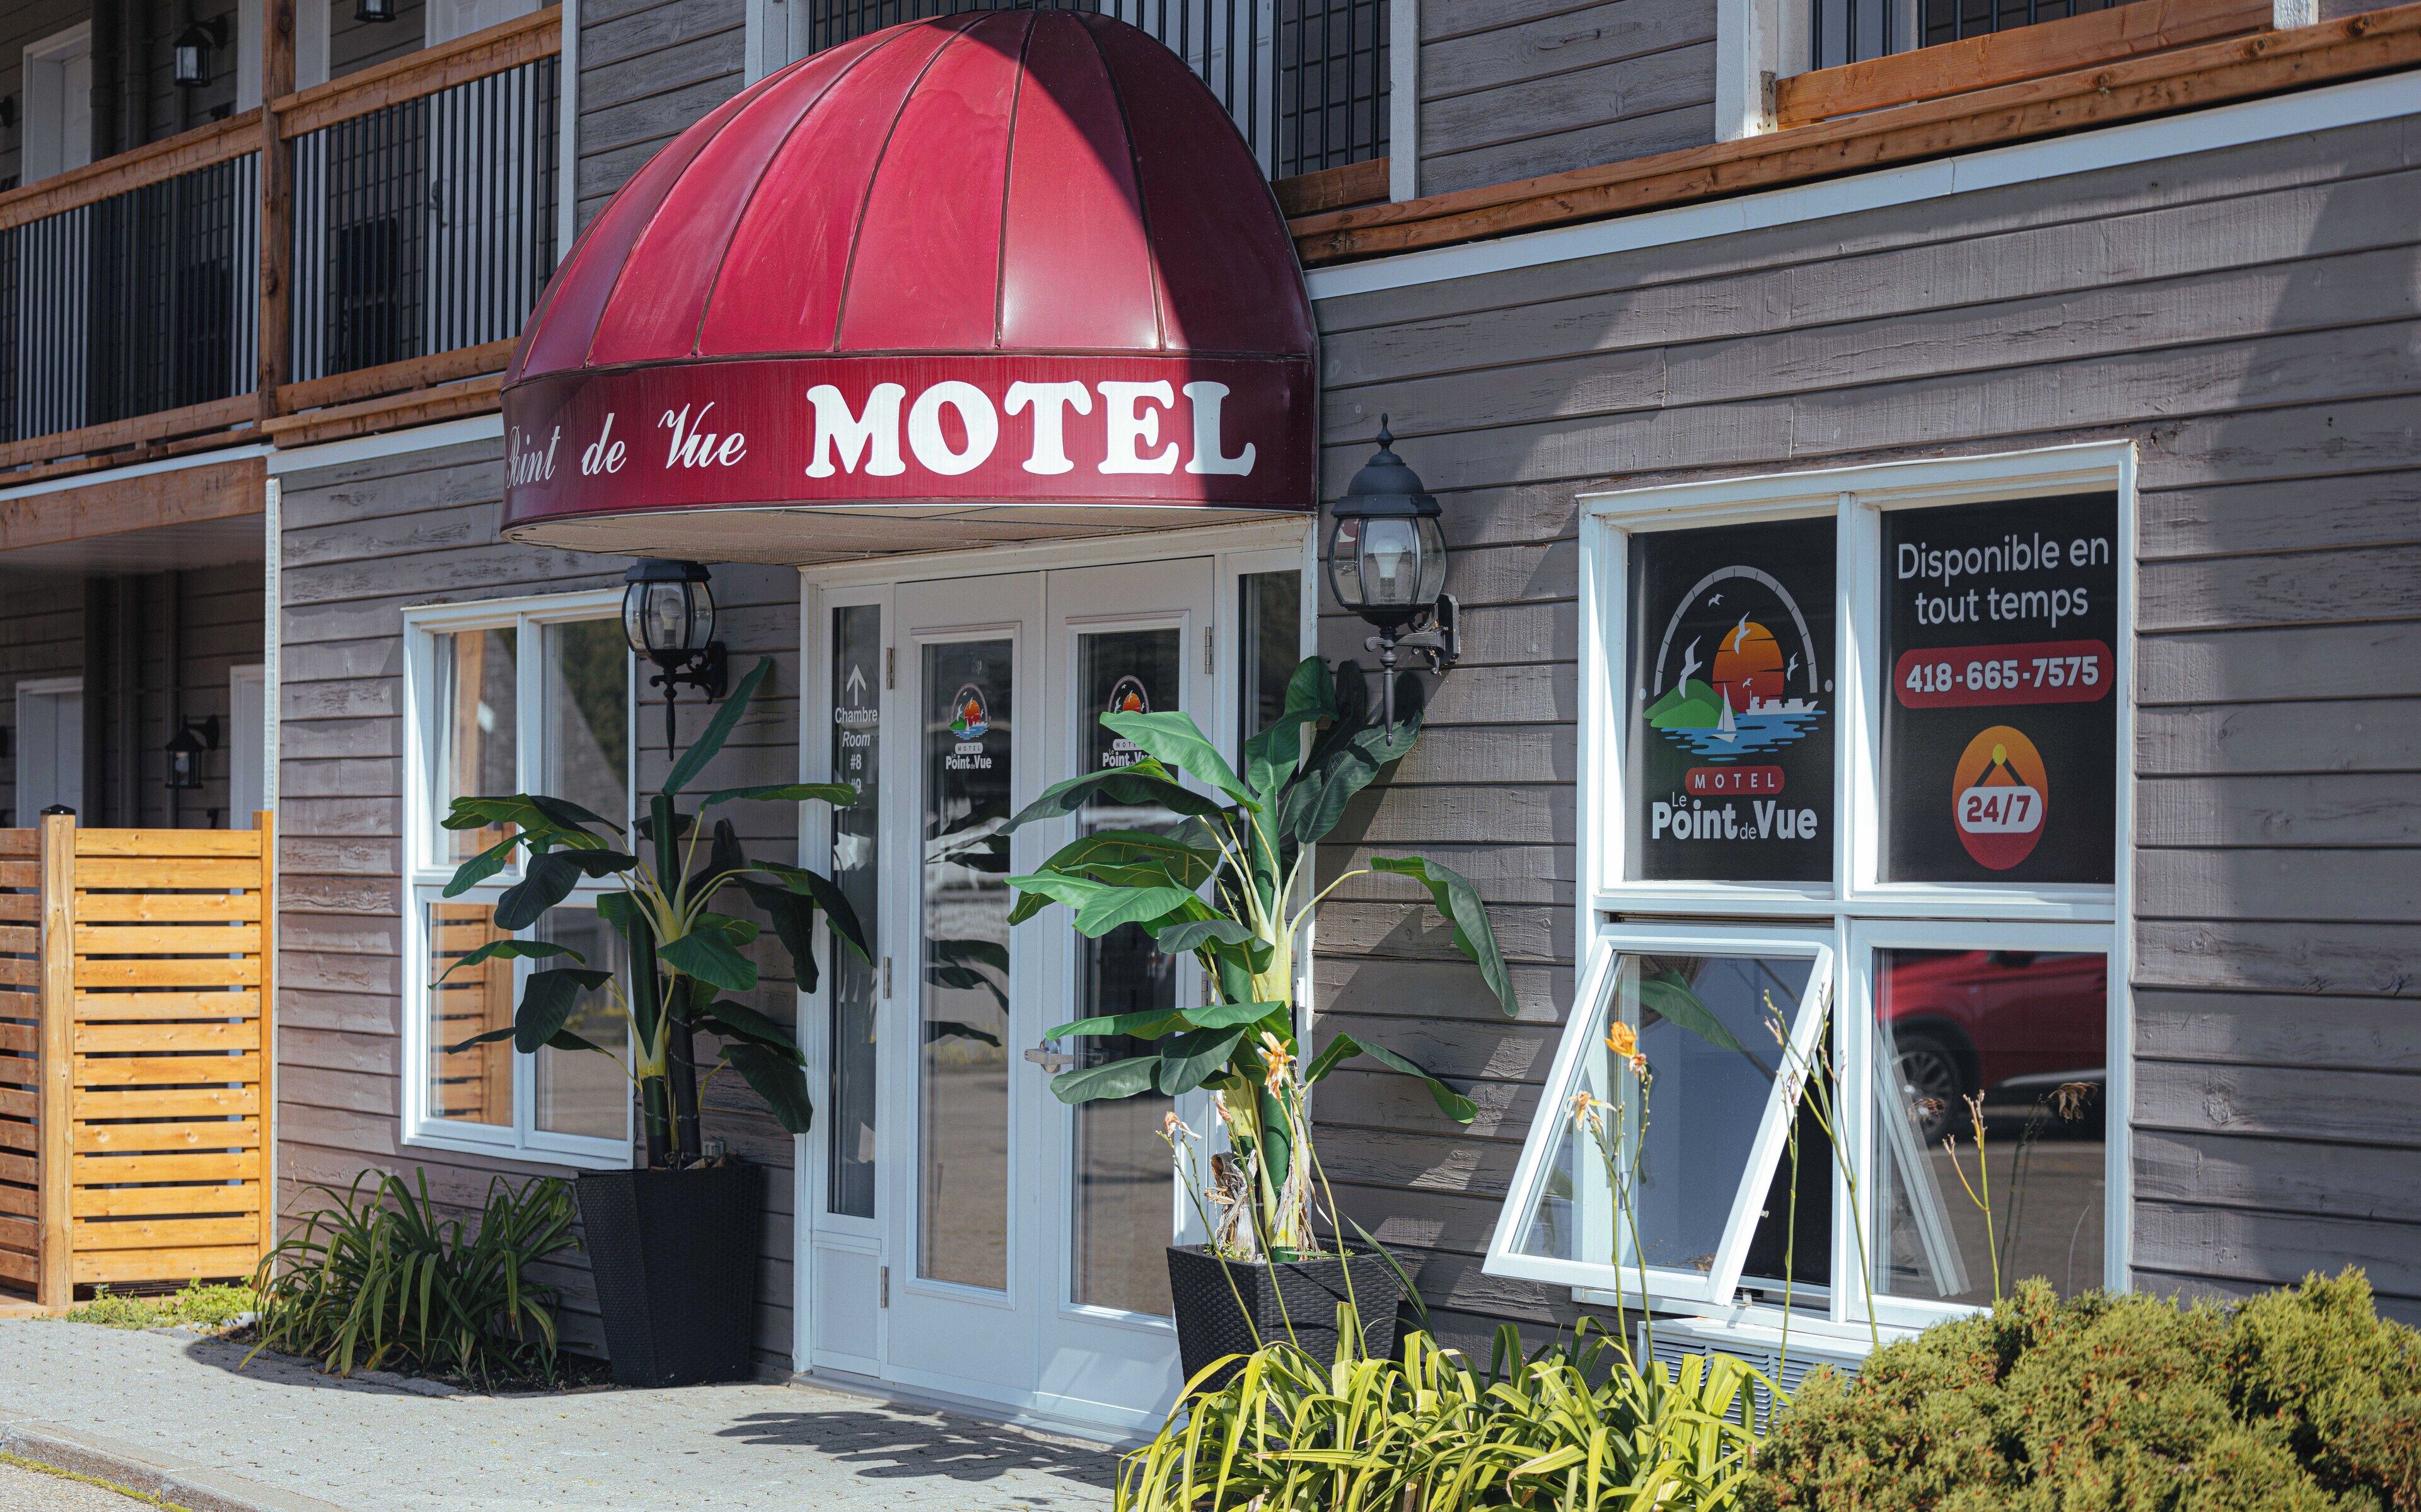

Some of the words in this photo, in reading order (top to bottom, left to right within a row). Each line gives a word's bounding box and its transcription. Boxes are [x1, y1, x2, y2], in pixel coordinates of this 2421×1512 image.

[507, 425, 560, 489] Point
[582, 413, 627, 476] de
[657, 401, 747, 470] Vue
[805, 379, 1256, 478] MOTEL
[1898, 533, 2060, 587] Disponible
[2069, 538, 2109, 567] en
[1915, 589, 1979, 625] tout
[1987, 587, 2088, 628] temps
[1905, 655, 2099, 693] 418-665-7575
[835, 707, 878, 724] Chambre
[842, 731, 871, 747] Room
[850, 754, 862, 770] #8
[946, 755, 970, 770] Point
[973, 754, 992, 769] Vue
[1103, 752, 1130, 767] Point
[1695, 773, 1775, 788] MOTEL
[1672, 792, 1687, 807] Le
[1966, 793, 2031, 826] 24/7
[1652, 799, 1738, 840] Point
[1739, 822, 1757, 840] de
[1753, 800, 1818, 840] Vue
